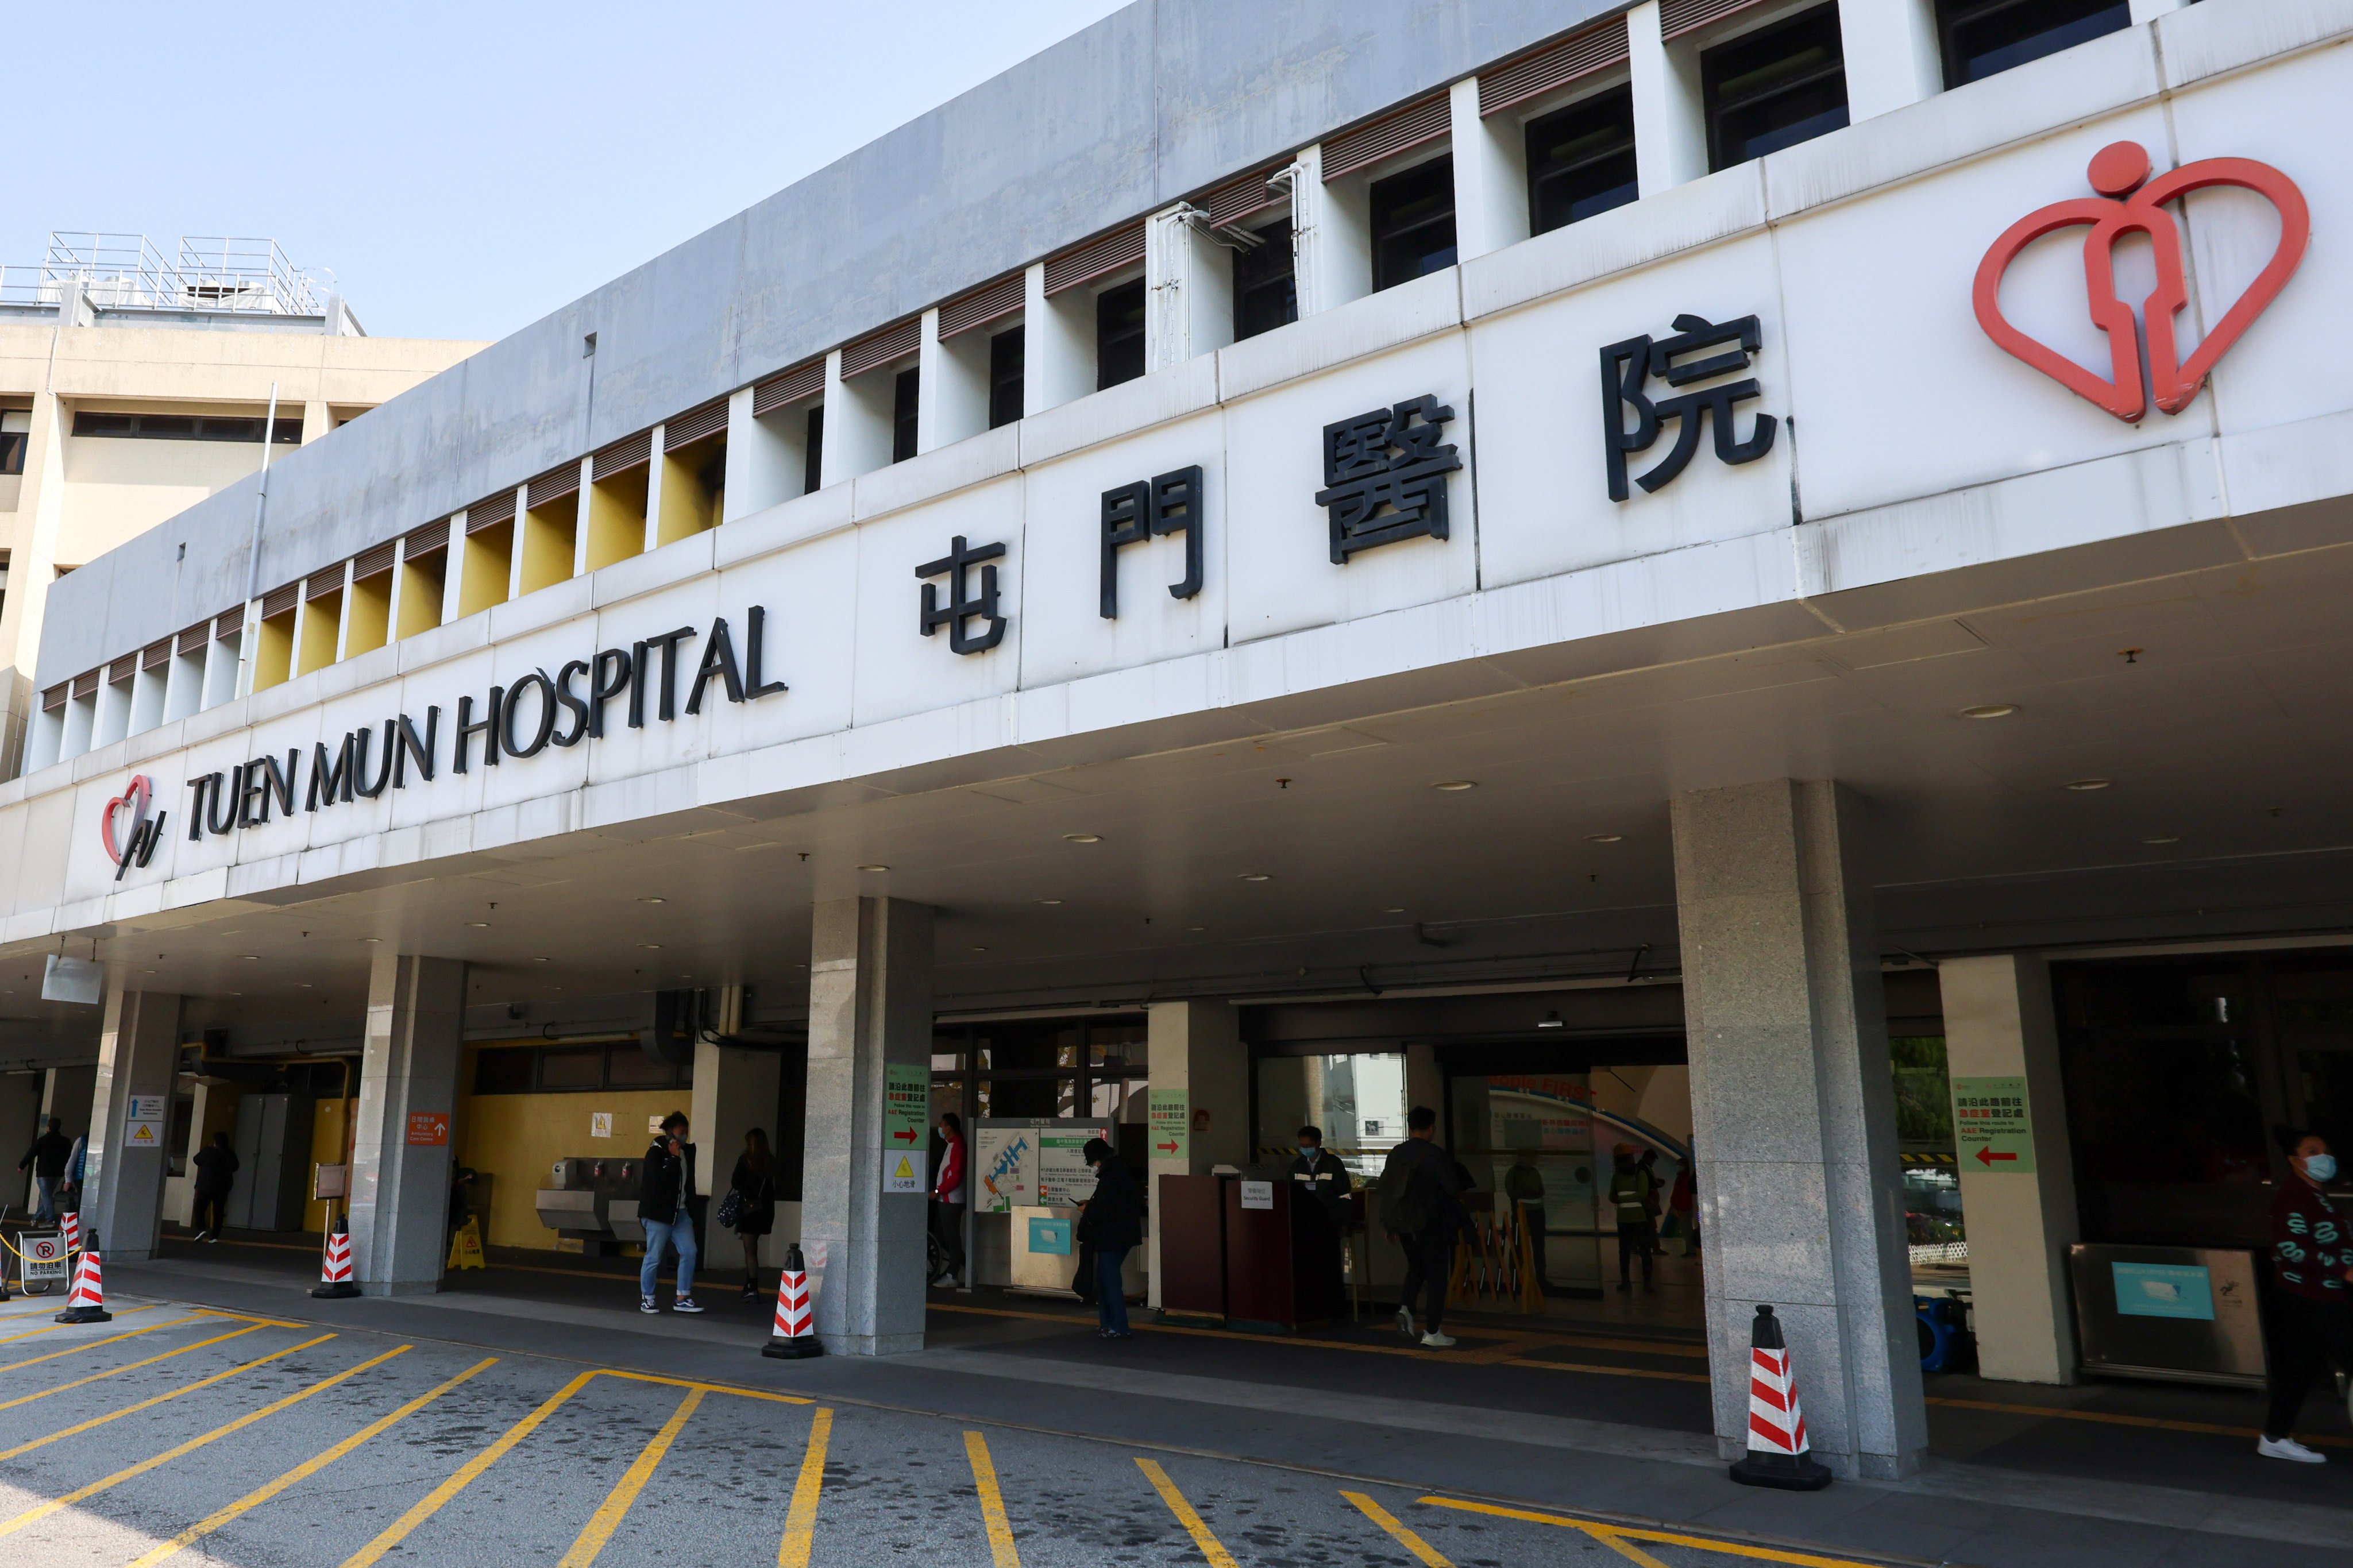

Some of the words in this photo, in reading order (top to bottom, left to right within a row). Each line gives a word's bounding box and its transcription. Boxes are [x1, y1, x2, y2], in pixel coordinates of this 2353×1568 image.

[915, 314, 1776, 655] 屯門醫院
[187, 748, 299, 841] TUEN
[305, 705, 439, 812] MUN
[453, 605, 788, 774] HOSPITAL
[889, 1082, 925, 1092] 請沿此路前往
[1488, 1074, 1536, 1090] eople
[1543, 1077, 1596, 1100] FIRS
[1957, 1098, 2023, 1106] 請沿此路前往
[1959, 1109, 2024, 1118] 急症室登記處
[893, 1180, 916, 1188] 小心地滑
